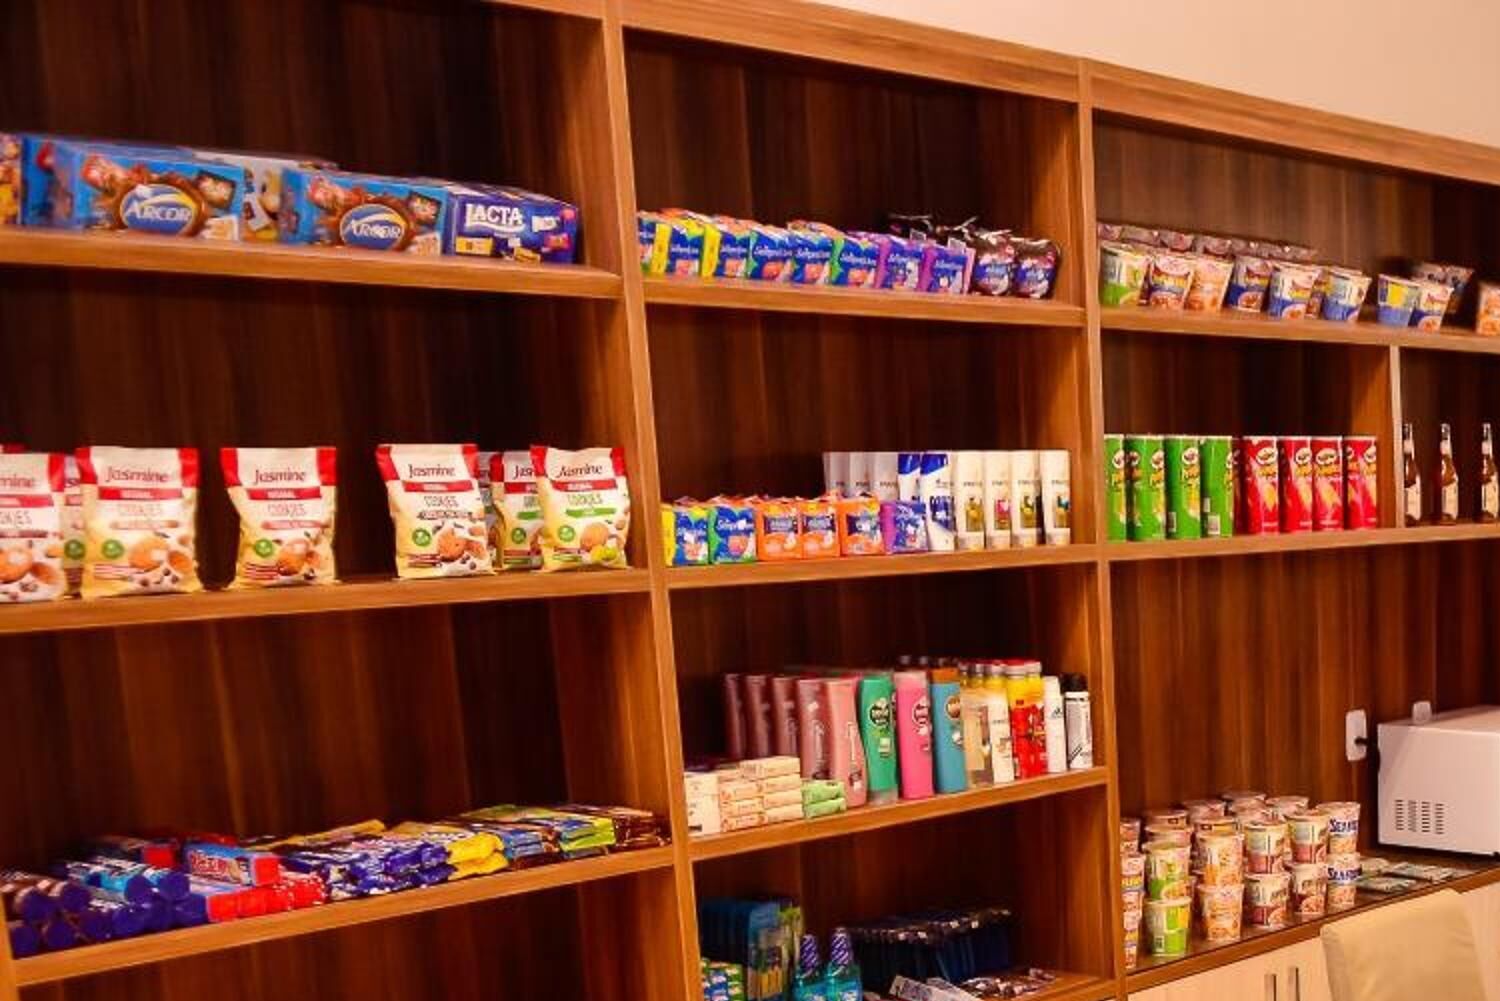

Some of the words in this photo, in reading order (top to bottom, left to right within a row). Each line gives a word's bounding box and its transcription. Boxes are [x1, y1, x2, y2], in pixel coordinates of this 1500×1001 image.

[125, 202, 193, 222] ARCOR
[465, 203, 525, 231] LACTA
[105, 466, 169, 483] Jasmine
[254, 465, 306, 483] Jasmine
[408, 463, 456, 478] Jasmine
[555, 464, 604, 478] Jasmine
